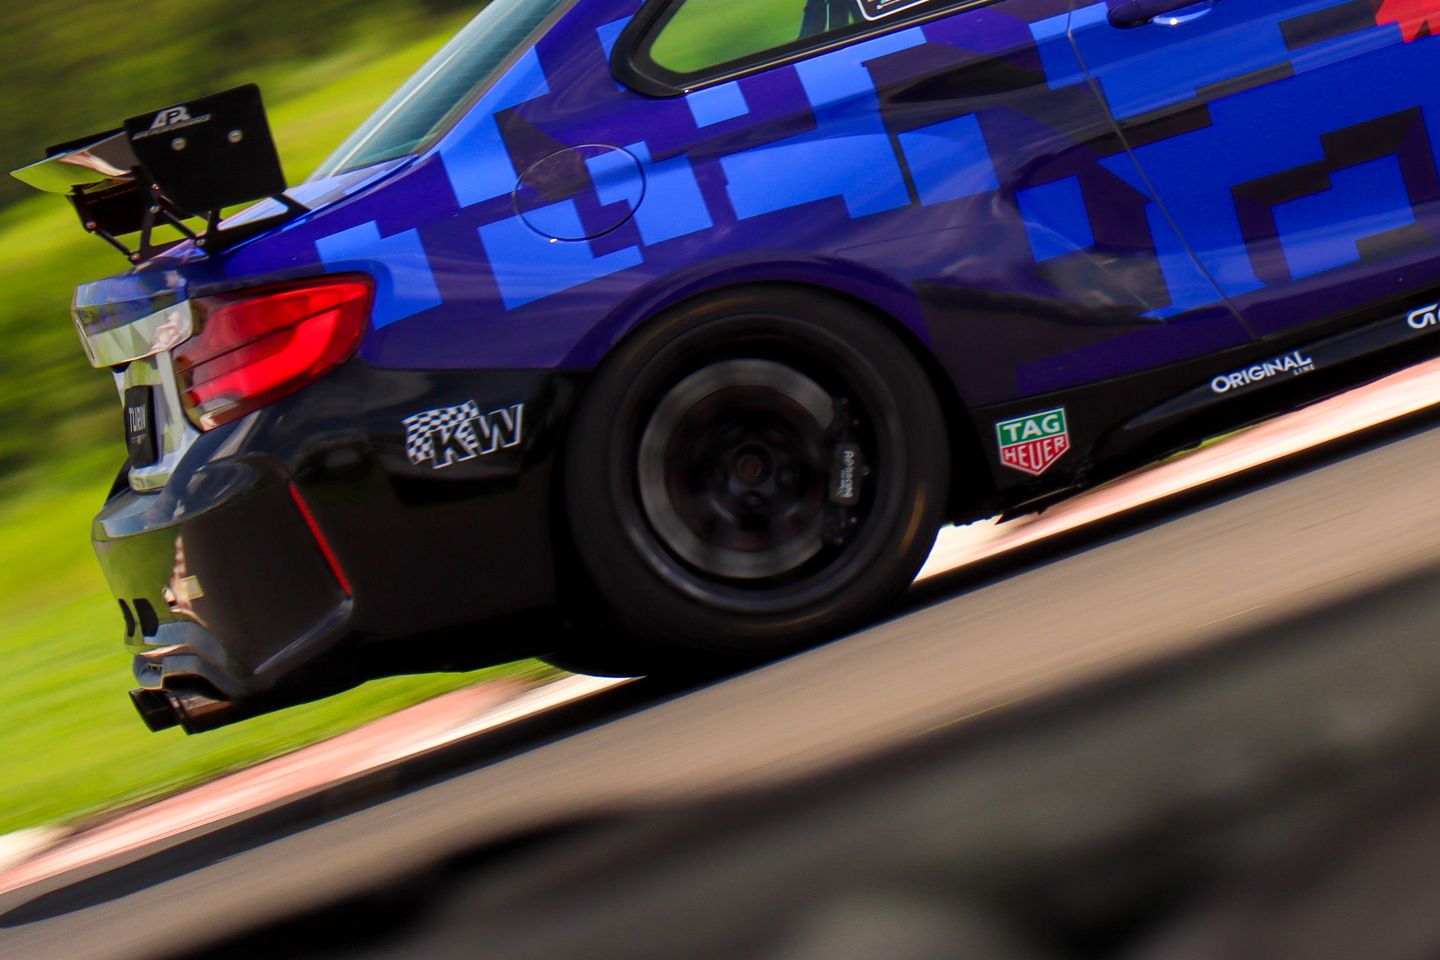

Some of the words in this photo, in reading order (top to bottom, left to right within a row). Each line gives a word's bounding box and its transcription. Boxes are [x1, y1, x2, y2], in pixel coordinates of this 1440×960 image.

[1211, 351, 1313, 393] ORIGINAL
[427, 403, 524, 470] KW
[1003, 414, 1061, 442] TAG
[1004, 437, 1064, 469] HEUER
